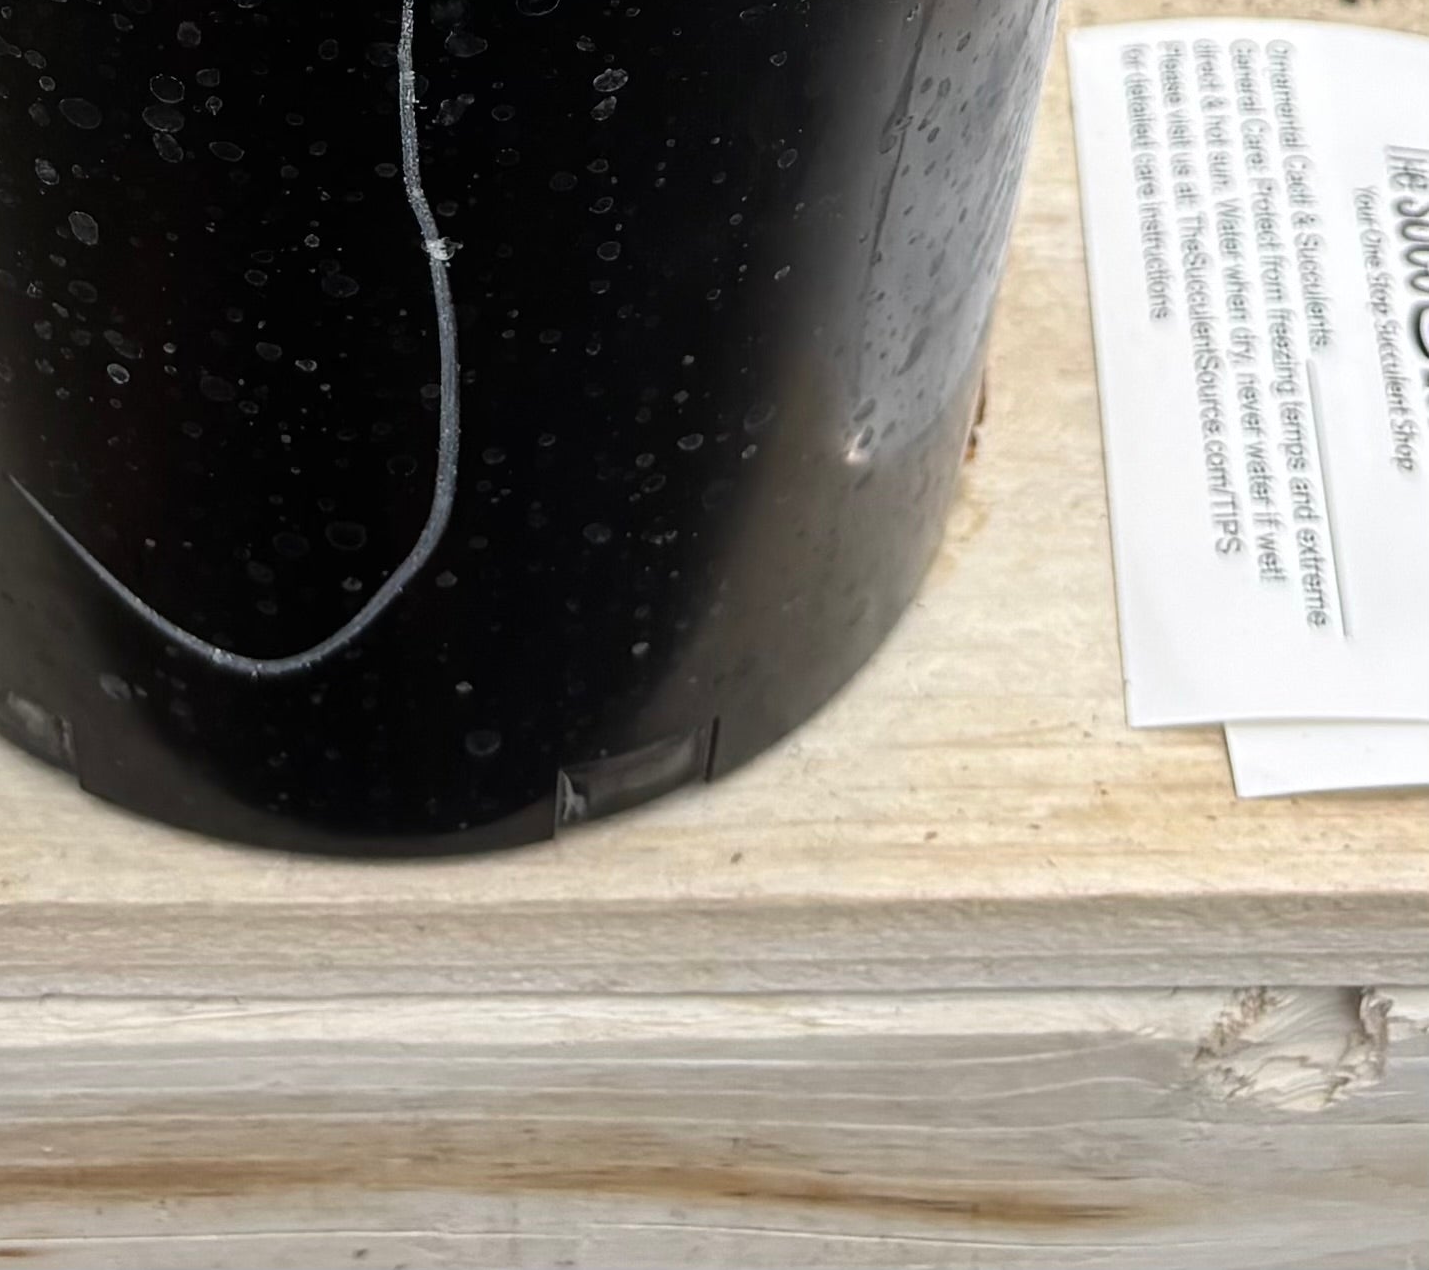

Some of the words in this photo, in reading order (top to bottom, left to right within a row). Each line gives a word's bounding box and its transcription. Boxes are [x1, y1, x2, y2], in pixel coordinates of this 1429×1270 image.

[1122, 43, 1151, 71] for
[1158, 42, 1187, 106] Please
[1192, 39, 1225, 93] direct
[1229, 39, 1265, 115] General
[1124, 73, 1161, 151] detailed
[1200, 95, 1230, 114] &
[1266, 39, 1309, 149] Ornamental
[1165, 108, 1196, 149] visit
[1204, 115, 1234, 148] hot
[1133, 153, 1161, 200] care
[1171, 152, 1199, 178] us
[1283, 155, 1318, 207] Cacti
[1214, 198, 1245, 259] Water
[1248, 178, 1282, 249] Protect
[1291, 211, 1320, 229] &
[1354, 185, 1379, 227] Your
[1138, 201, 1173, 320] instructions
[1360, 228, 1389, 268] One
[1222, 264, 1252, 321] when
[1259, 255, 1290, 302] from
[1367, 272, 1394, 316] Stop
[1226, 327, 1258, 363] dry,
[1268, 308, 1299, 397] freezing
[1375, 319, 1409, 416] Succulent
[1176, 211, 1246, 555] TheSucculentSource.com/TIPS
[1236, 372, 1262, 435] never
[1277, 401, 1310, 473] temps
[1391, 418, 1420, 472] Shop
[1244, 440, 1276, 507] water
[1290, 476, 1320, 524] and
[1252, 510, 1287, 528] if
[1297, 527, 1331, 629] extreme
